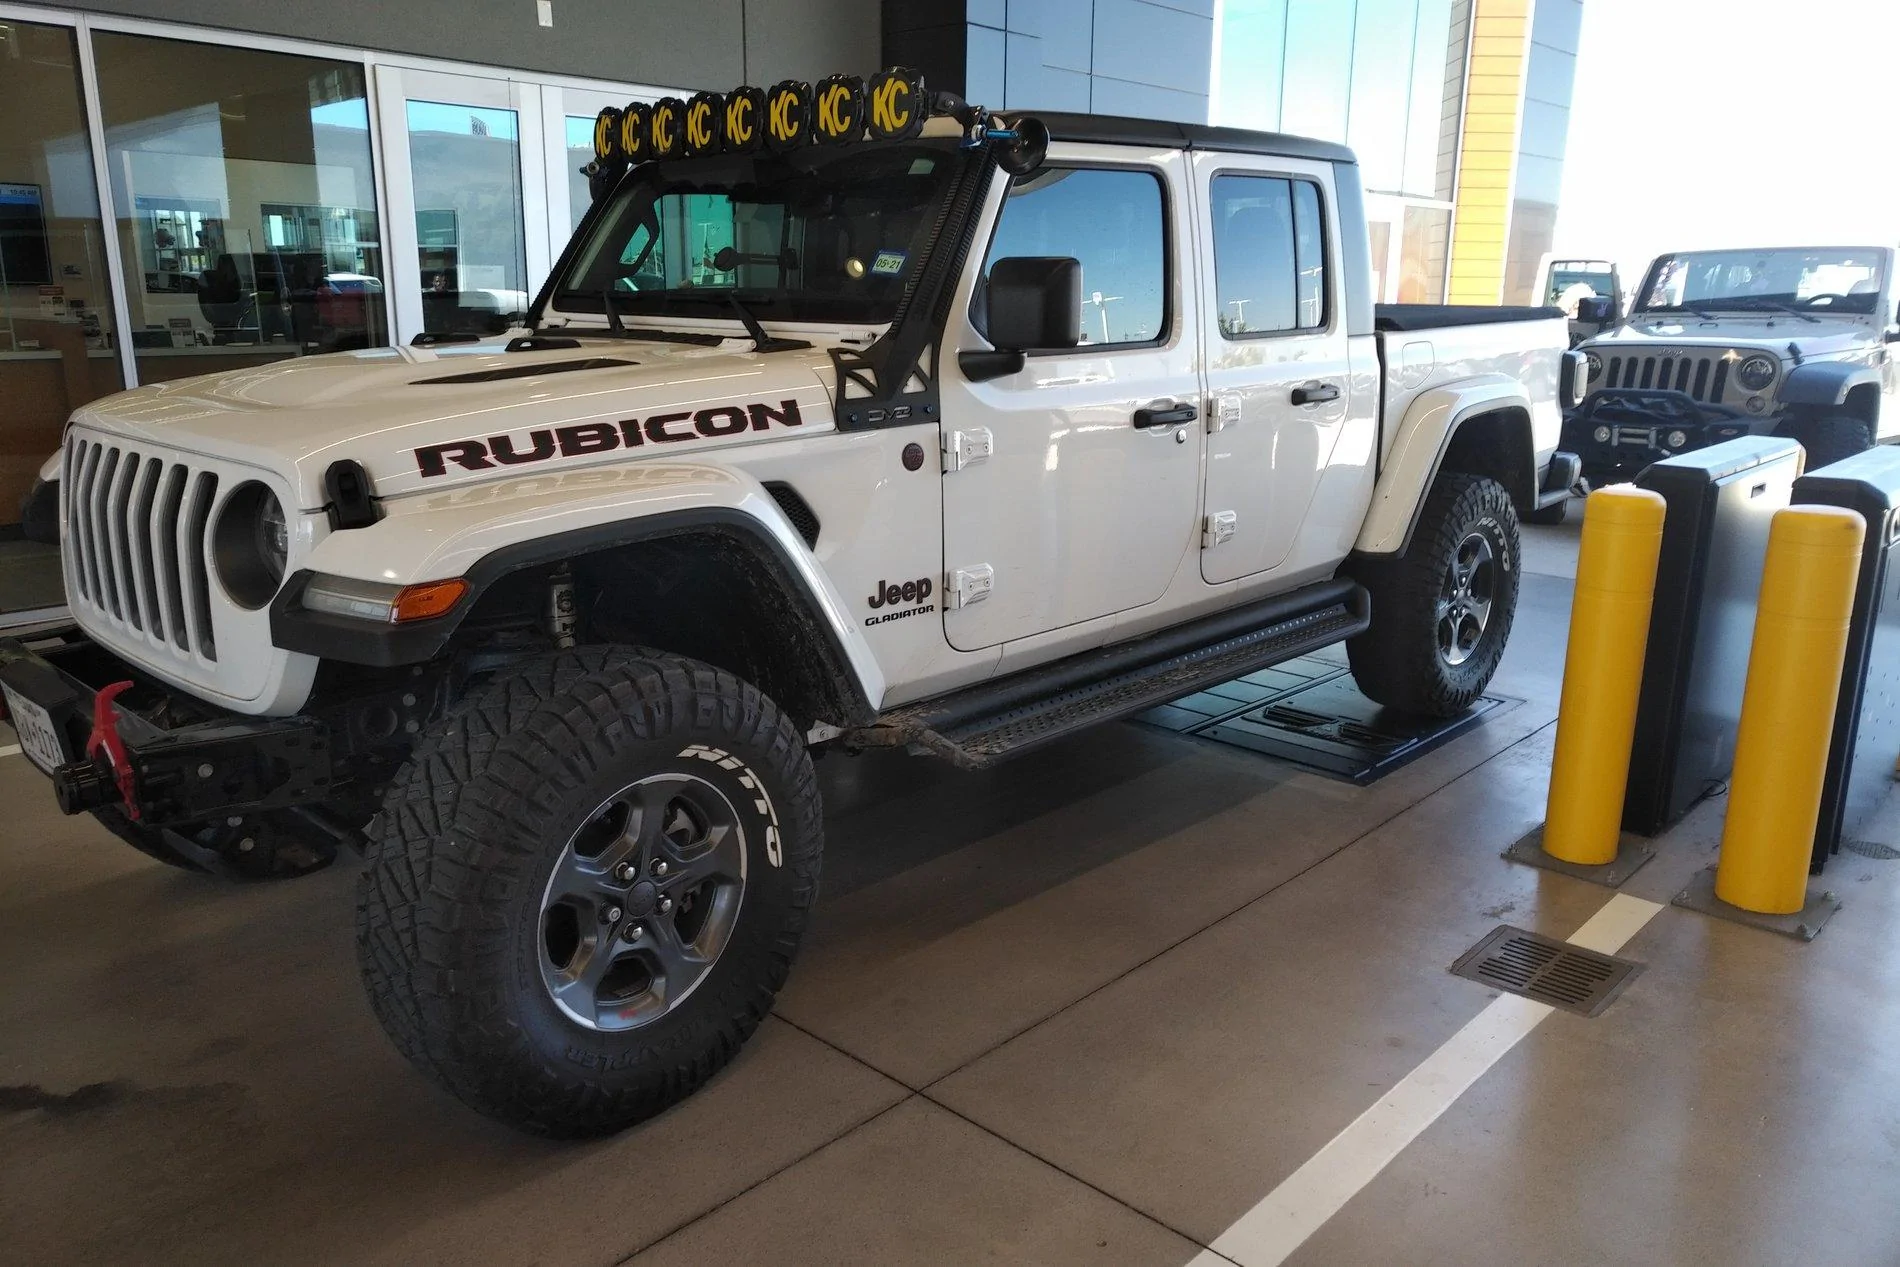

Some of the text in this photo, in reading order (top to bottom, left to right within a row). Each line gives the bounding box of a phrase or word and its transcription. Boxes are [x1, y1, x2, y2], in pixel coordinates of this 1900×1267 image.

[652, 105, 673, 152] KC
[687, 101, 711, 149] KC
[727, 96, 752, 145] KC
[770, 90, 799, 141] KC
[819, 84, 851, 136] KC
[873, 77, 909, 132] KC
[596, 116, 611, 158] KC
[622, 111, 640, 155] KC
[414, 399, 802, 478] RUBICON
[1475, 517, 1510, 571] NITTO
[865, 605, 934, 626] GLADIATOR
[868, 578, 932, 609] Jeep
[676, 744, 782, 868] NITTO
